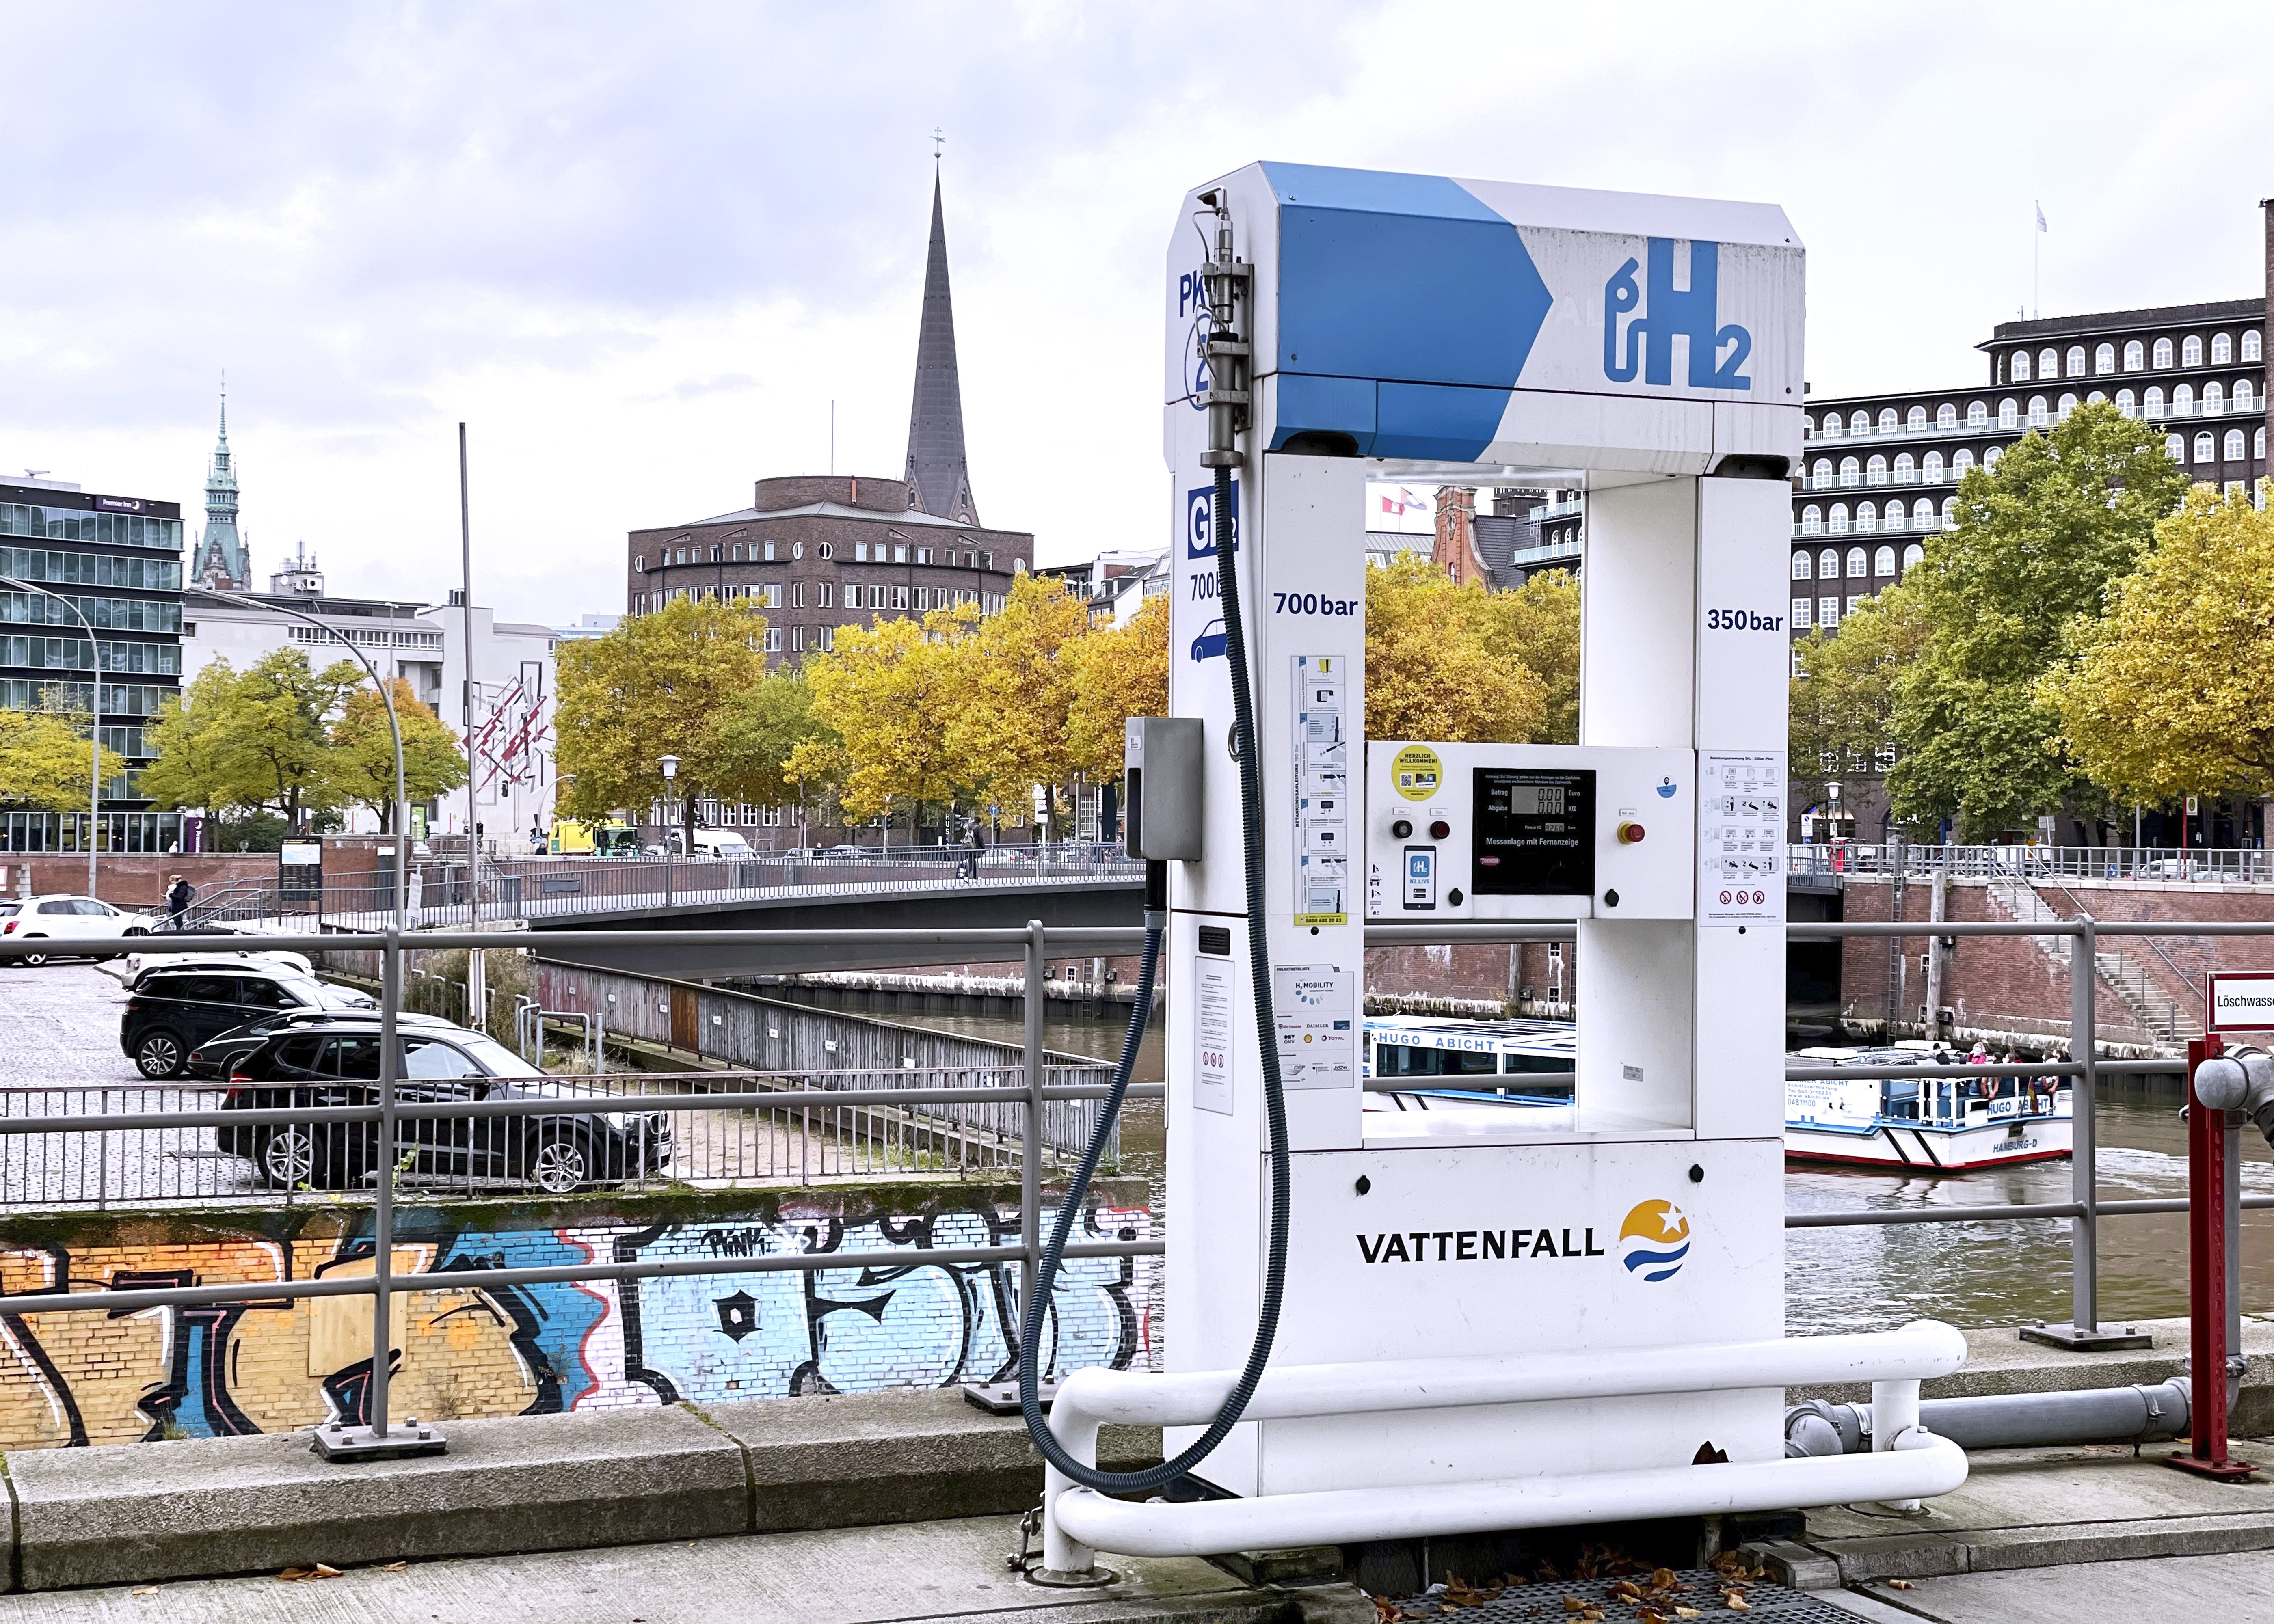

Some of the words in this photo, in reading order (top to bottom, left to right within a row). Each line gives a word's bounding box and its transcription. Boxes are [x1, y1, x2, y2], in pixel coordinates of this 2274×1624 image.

[1180, 270, 1206, 317] PK
[102, 499, 123, 507] Premier
[1486, 838, 1525, 847] Messanlage
[1539, 838, 1578, 847] Fernanzeige
[1379, 1032, 1420, 1045] HUGO
[1435, 1037, 1495, 1052] ABICHT
[1788, 1083, 1837, 1091] Schiffsvermietung
[1788, 1098, 1816, 1107] 04811100
[1987, 1101, 2011, 1116] HUGO
[2018, 1098, 2049, 1110] ABHT
[1355, 1227, 1604, 1264] VATTENFALL
